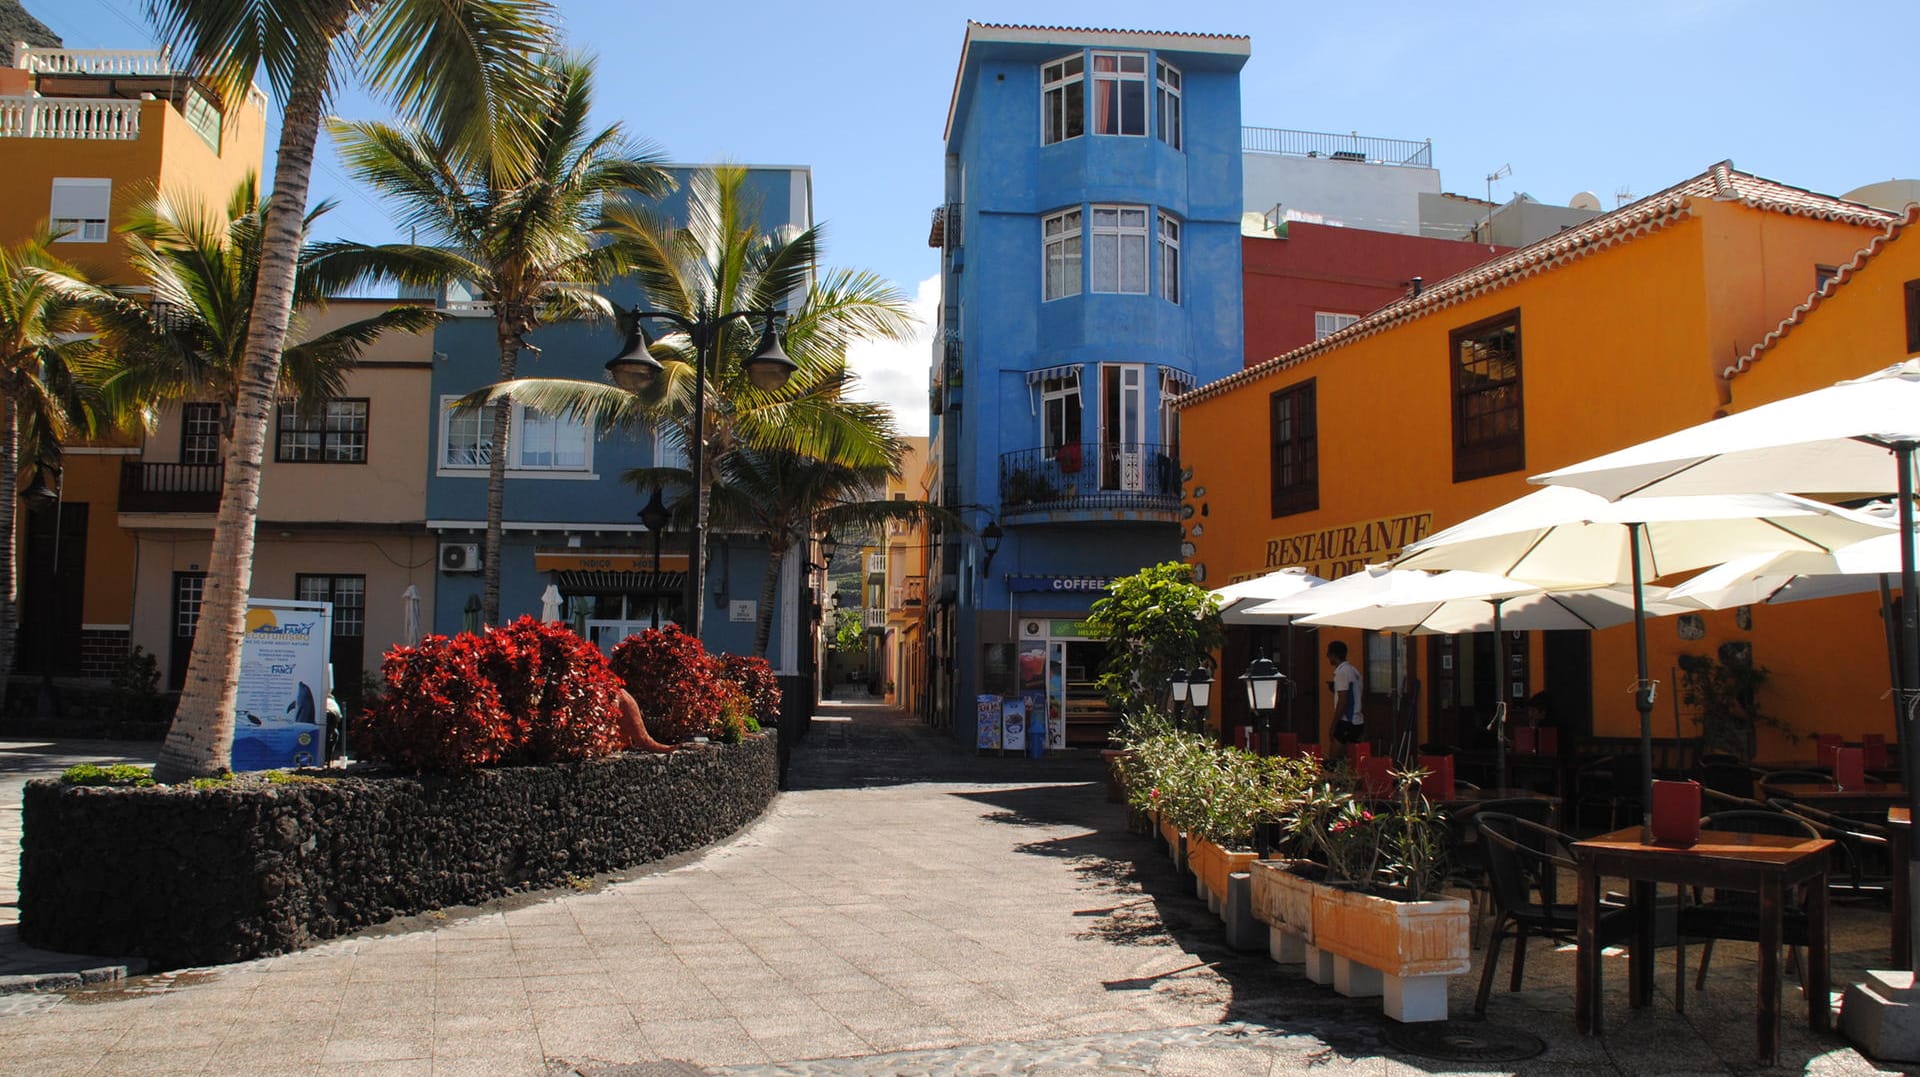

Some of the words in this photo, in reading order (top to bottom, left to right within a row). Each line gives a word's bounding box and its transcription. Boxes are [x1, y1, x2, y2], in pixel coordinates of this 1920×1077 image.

[1265, 513, 1432, 568] RESTAURANTE
[1053, 579, 1105, 590] COFFEE
[284, 622, 316, 635] FANCY
